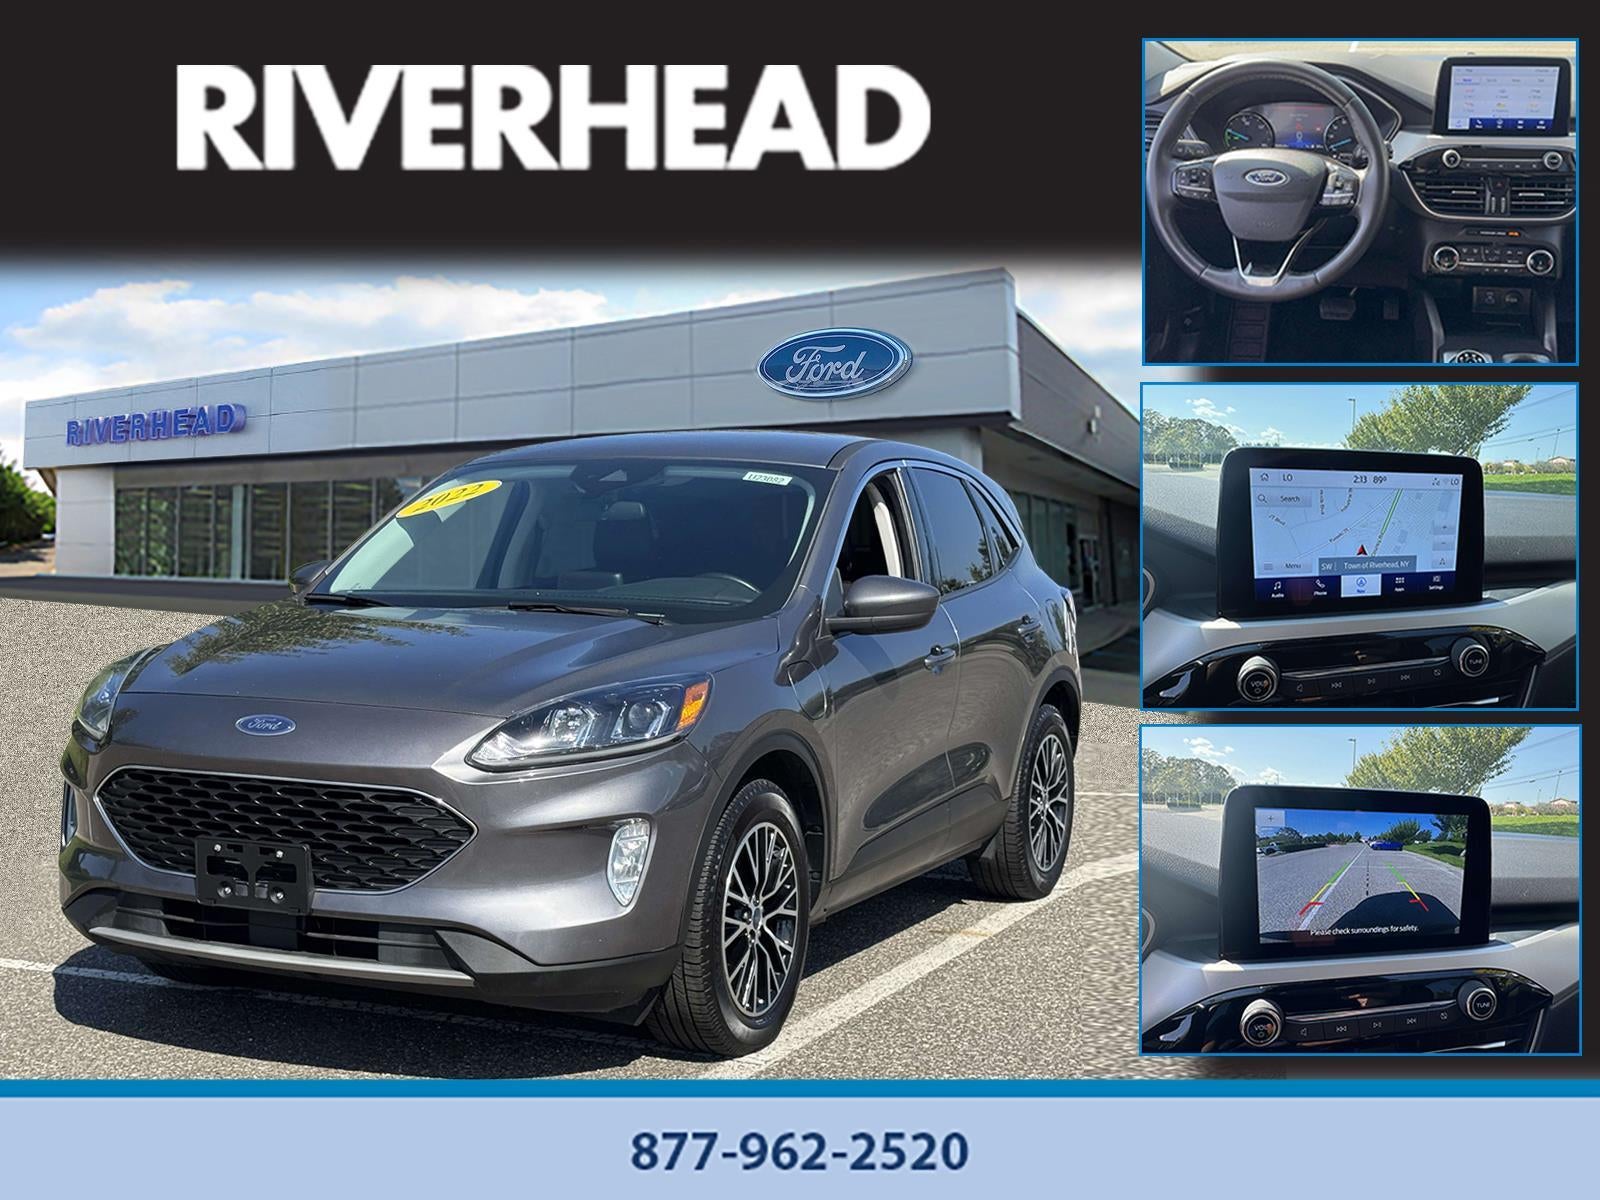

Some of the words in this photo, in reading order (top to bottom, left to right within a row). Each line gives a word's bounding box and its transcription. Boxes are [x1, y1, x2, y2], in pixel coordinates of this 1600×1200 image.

[785, 344, 867, 383] Ford
[66, 403, 244, 446] RIVERHEAD
[1353, 475, 1368, 484] 2:13
[412, 484, 484, 512] 2022
[1280, 495, 1301, 503] Search
[1321, 562, 1333, 571] SW
[1343, 562, 1361, 570] Town
[1362, 560, 1369, 569] of
[1370, 560, 1400, 569] Riverhead,
[1400, 560, 1410, 568] NY
[247, 718, 282, 730] Ford
[1351, 926, 1390, 934] surroundings
[1399, 924, 1419, 932] safety.
